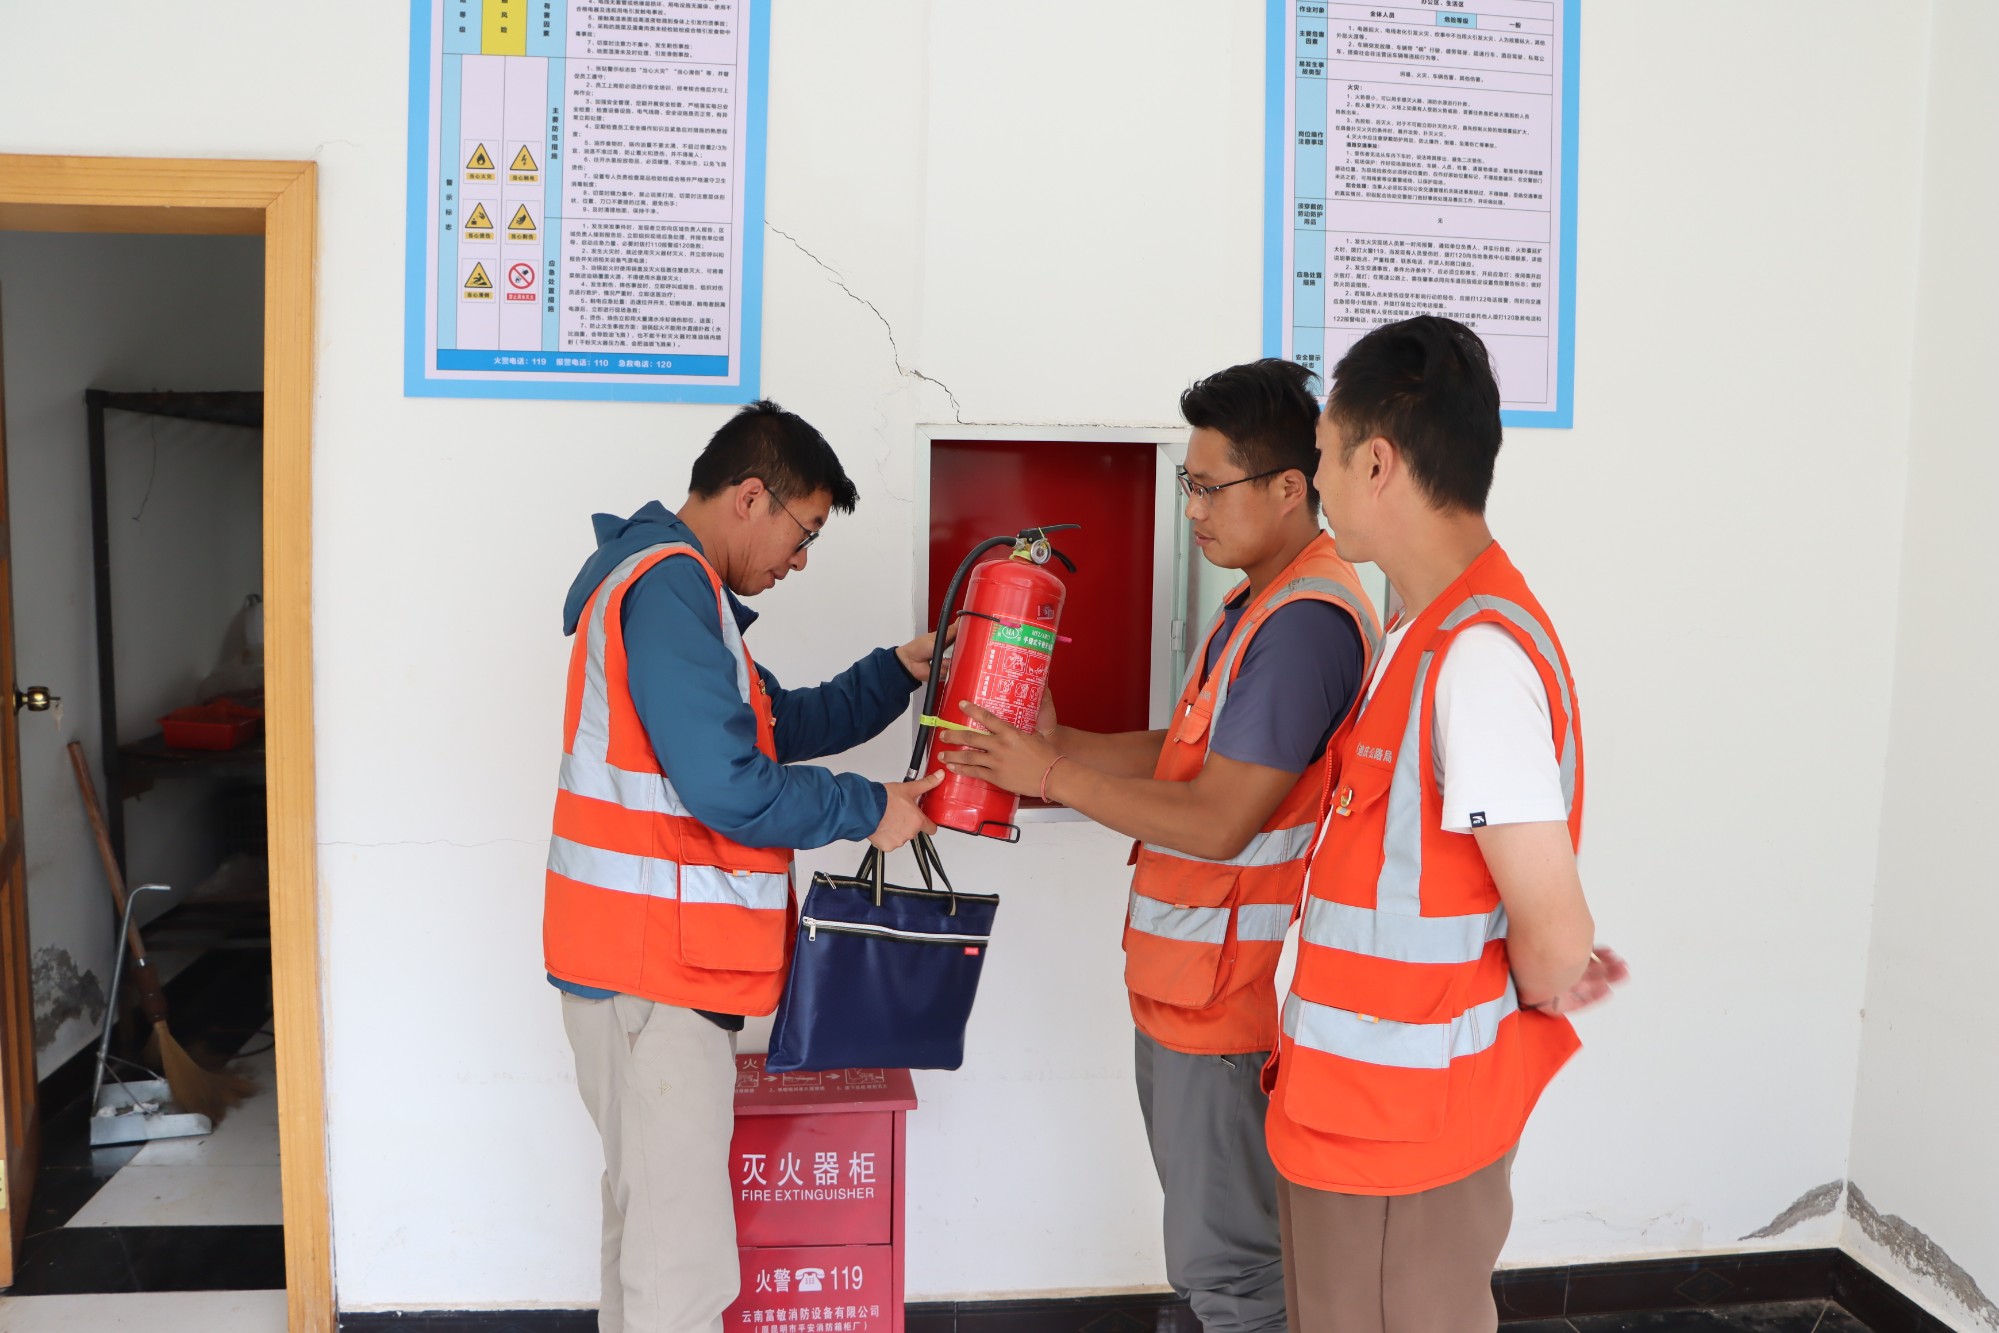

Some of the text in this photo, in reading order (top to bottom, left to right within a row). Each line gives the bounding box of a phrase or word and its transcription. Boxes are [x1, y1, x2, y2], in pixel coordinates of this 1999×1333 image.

[1370, 11, 1395, 19] 全体人员
[1444, 16, 1469, 24] 危险等级
[551, 108, 559, 159] 主要防范措施
[1298, 130, 1324, 139] 岗位操作
[1298, 138, 1324, 146] 注意事项
[494, 356, 672, 369] 火警电话：119 报警电话：110 急救电话：120
[742, 1152, 876, 1186] 灭火器柜
[742, 1188, 874, 1201] FIRE EXTINGUISHER
[756, 1266, 863, 1293] 火警 119
[742, 1305, 879, 1323] 云南富敏消防设备有限公司
